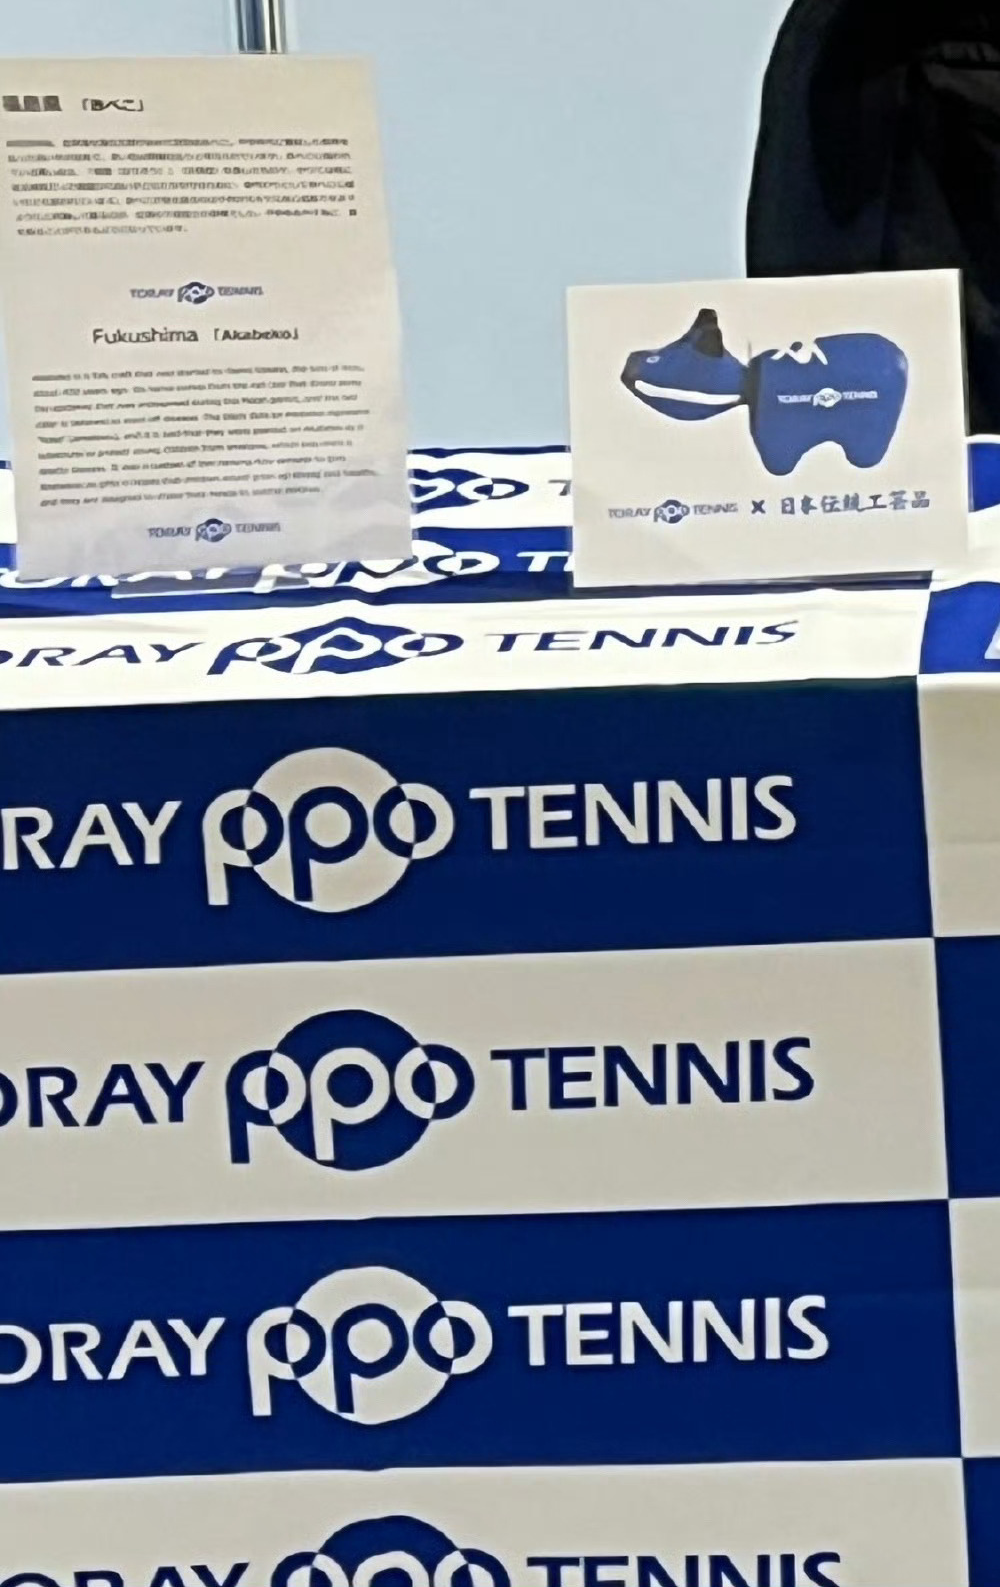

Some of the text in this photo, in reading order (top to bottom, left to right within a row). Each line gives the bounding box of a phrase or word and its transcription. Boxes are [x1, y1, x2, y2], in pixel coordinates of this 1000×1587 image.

[92, 327, 199, 344] Fukushima
[485, 620, 799, 652] TENNIS
[469, 775, 797, 851] TENNIS
[0, 1060, 206, 1128] RAY
[490, 1036, 815, 1112] TENNIS
[508, 1294, 830, 1369] TENNIS
